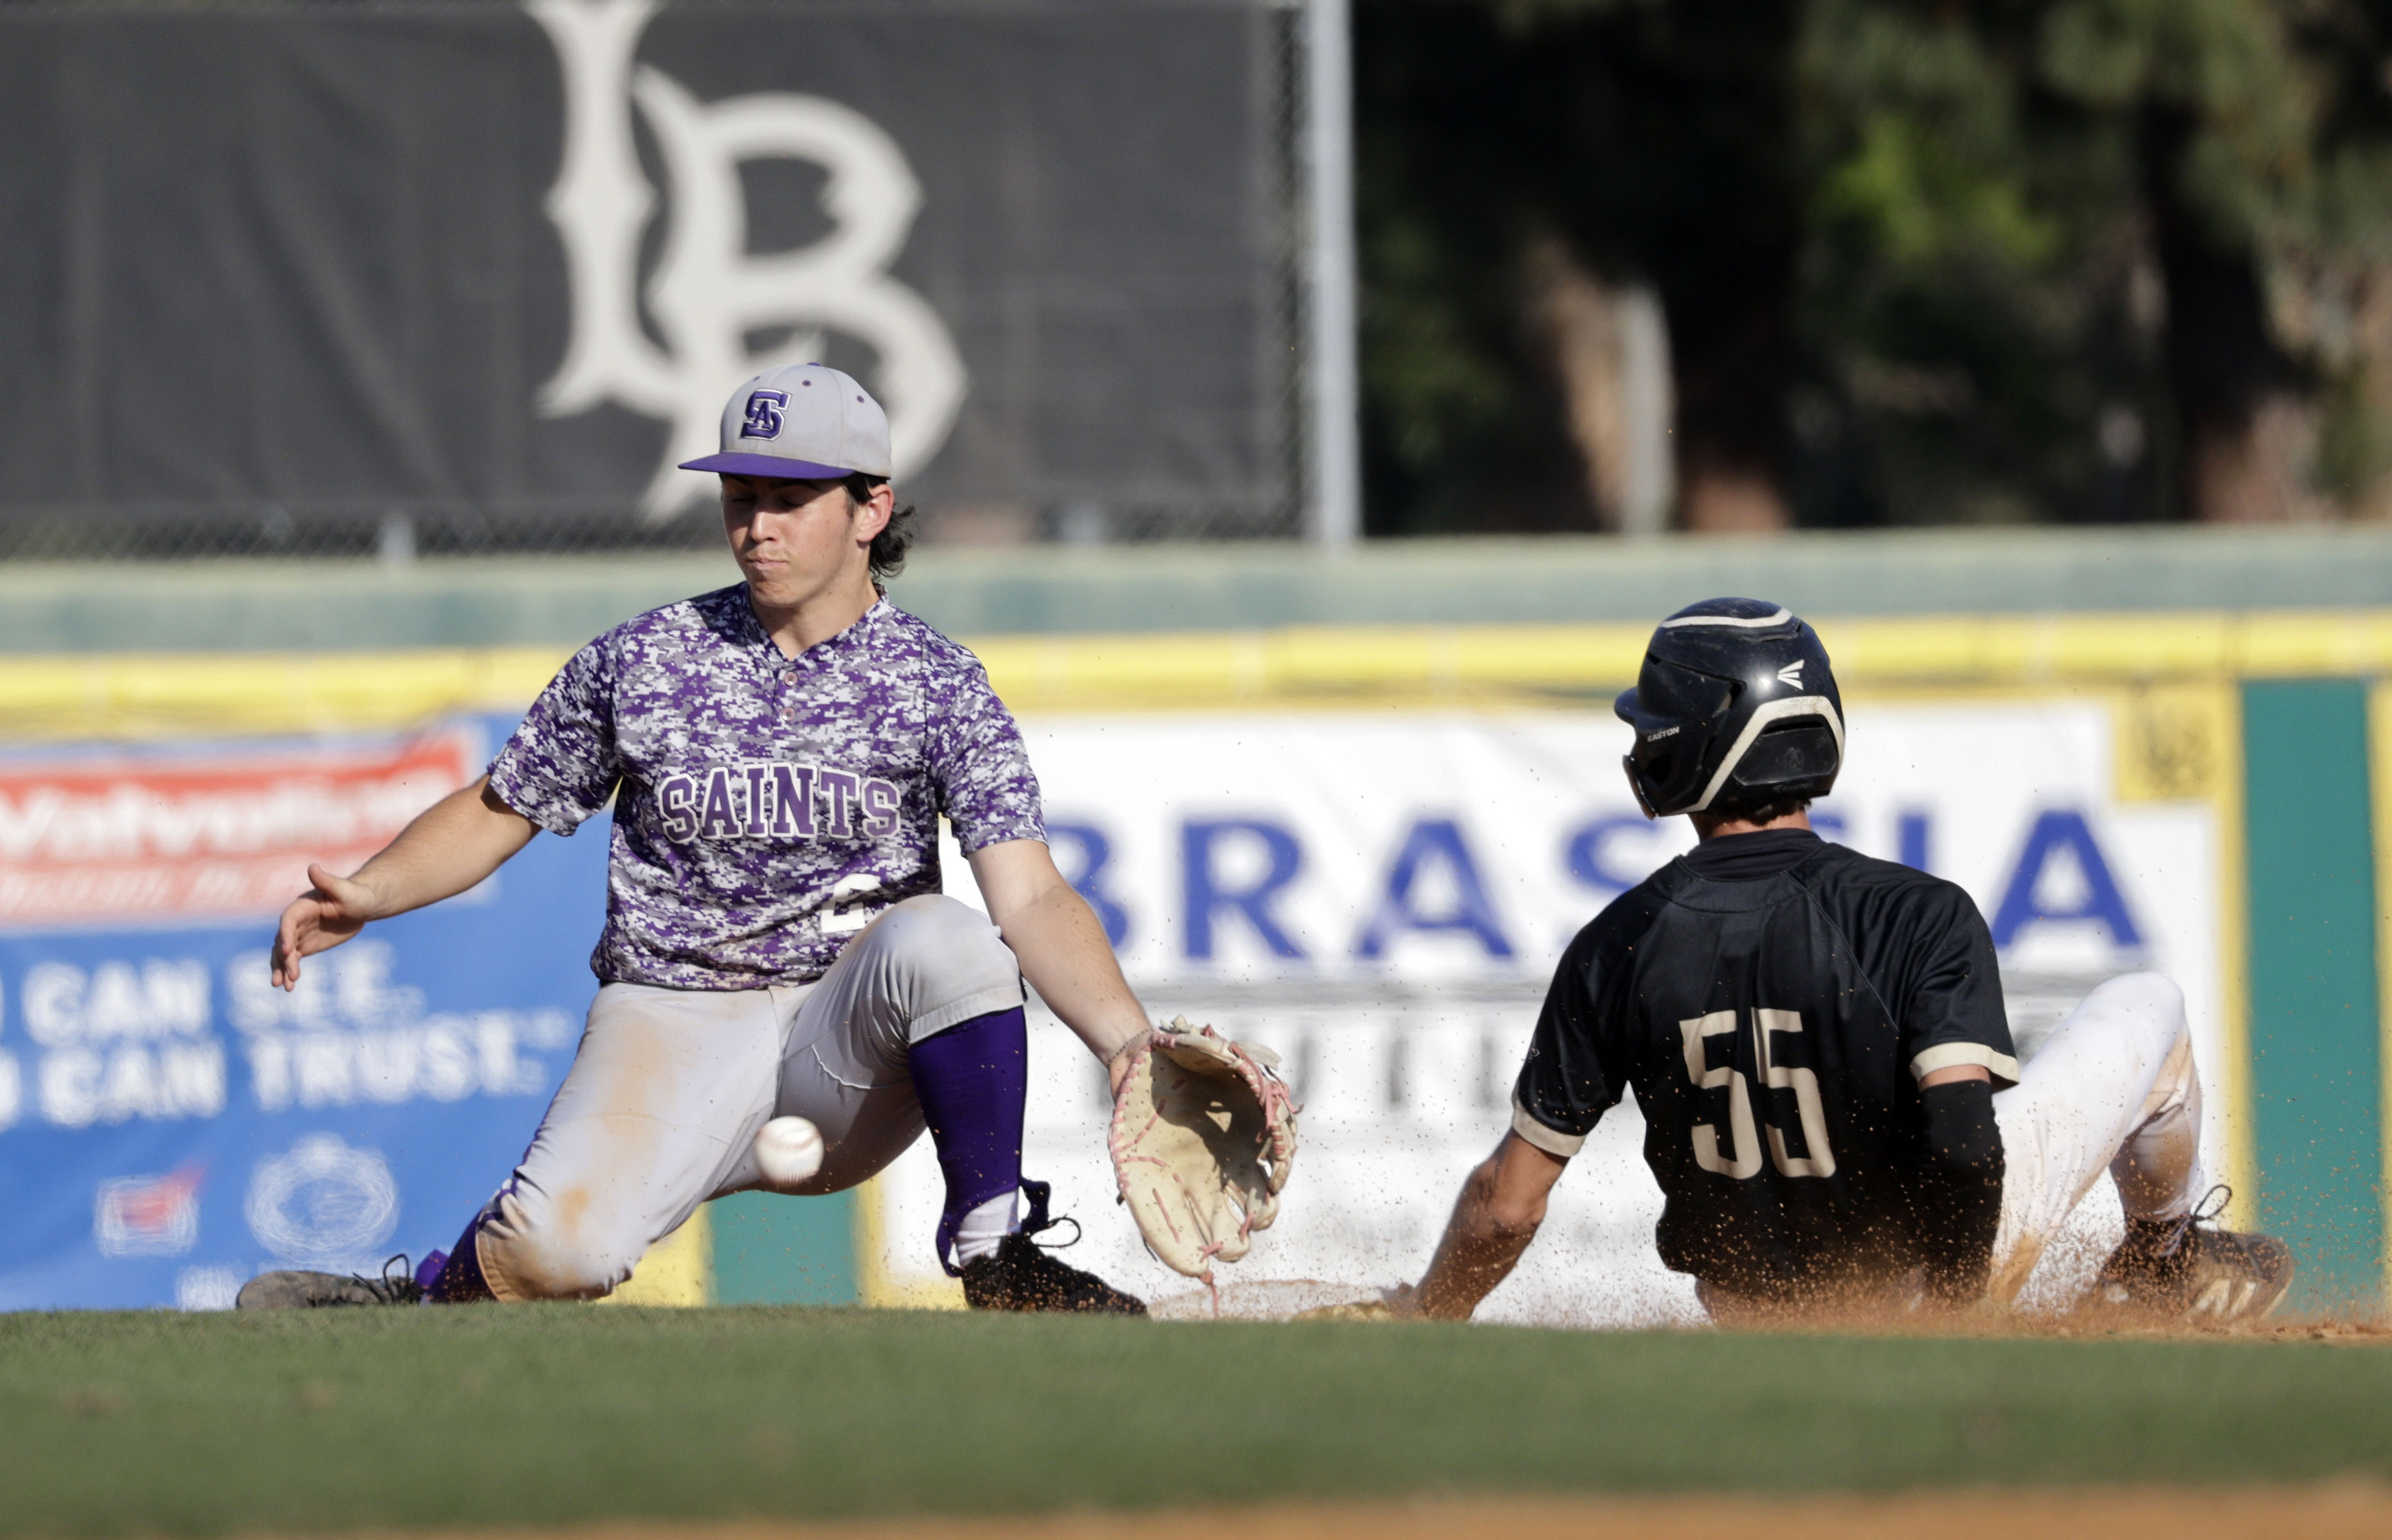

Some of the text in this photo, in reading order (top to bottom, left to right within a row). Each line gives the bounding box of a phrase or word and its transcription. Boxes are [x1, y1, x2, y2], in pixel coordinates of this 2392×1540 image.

[1647, 726, 1680, 743] EASTON
[658, 763, 902, 844] SAINTS
[23, 958, 212, 1044] CAN
[41, 1037, 226, 1127] CAN
[1679, 1007, 1836, 1179] 55
